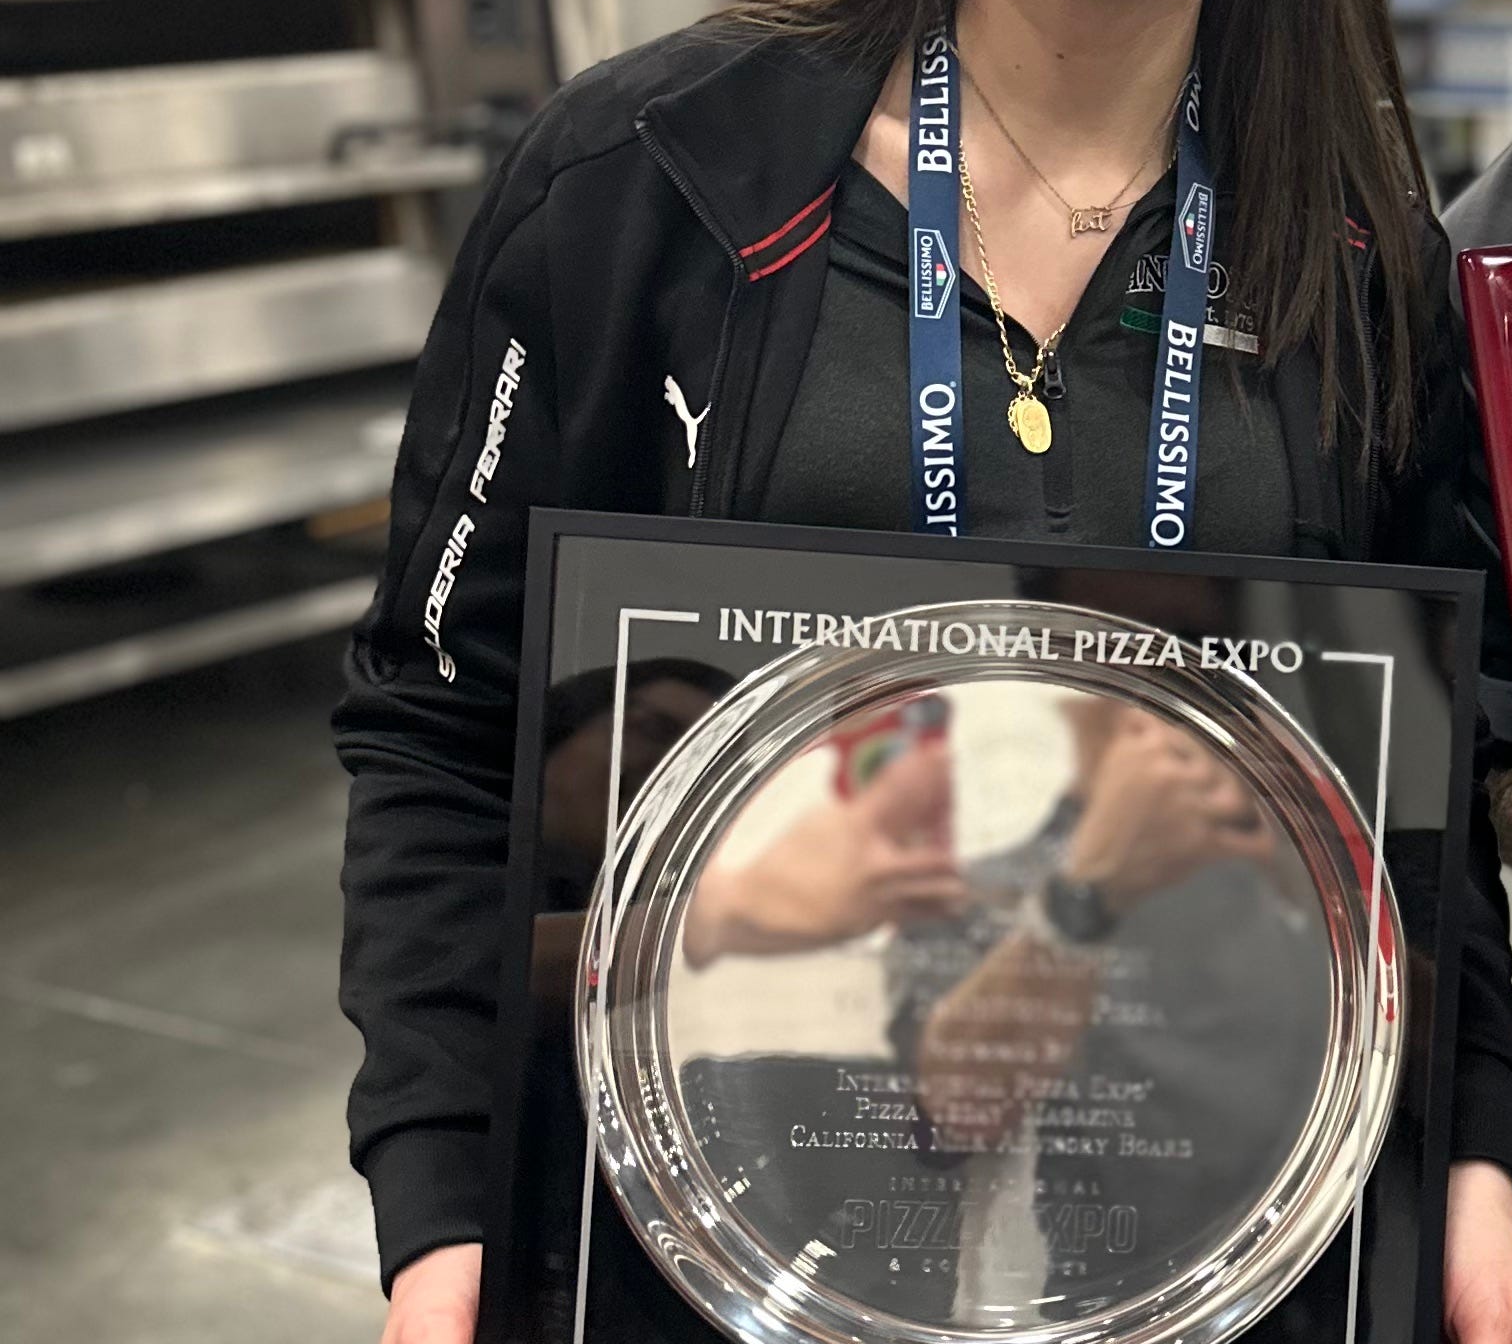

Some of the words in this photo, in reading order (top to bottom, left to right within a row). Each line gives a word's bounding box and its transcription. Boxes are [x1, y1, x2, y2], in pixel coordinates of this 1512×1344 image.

[917, 22, 953, 173] BELLISS
[1193, 191, 1208, 265] BELLISSIMO
[920, 235, 934, 311] BELLISSIMO
[919, 383, 957, 537] ISSIMO
[1151, 320, 1198, 547] BELLISSIMO
[424, 513, 476, 683] SUDERIA
[470, 337, 527, 504] FERRARI
[718, 607, 1061, 662] INTERNATIONAL
[1074, 629, 1186, 668] PIZZA
[1200, 637, 1303, 674] EXPO
[790, 1124, 919, 1150] CALIFORNIA
[854, 1097, 920, 1121] PIZZA
[840, 1199, 986, 1250] PIZZ
[1020, 1203, 1138, 1254] XPO
